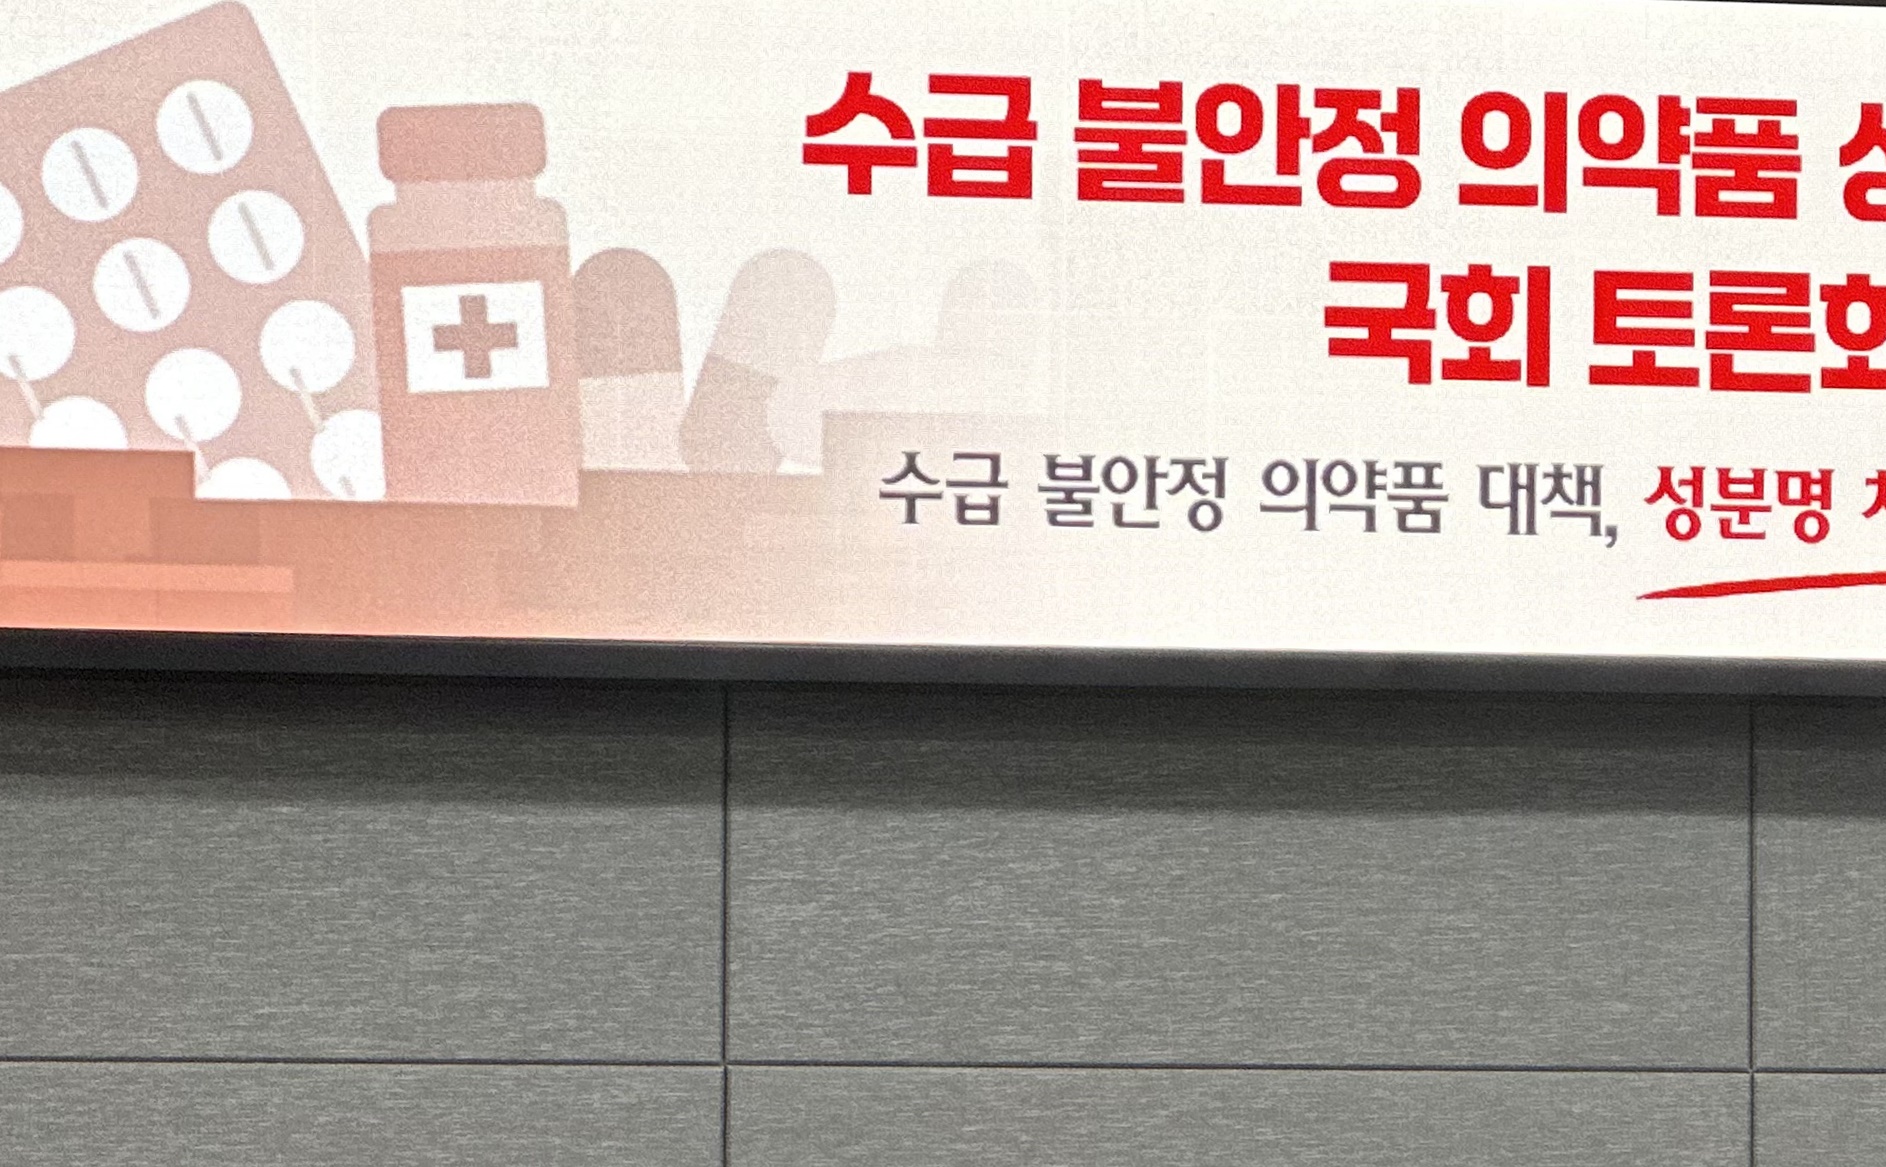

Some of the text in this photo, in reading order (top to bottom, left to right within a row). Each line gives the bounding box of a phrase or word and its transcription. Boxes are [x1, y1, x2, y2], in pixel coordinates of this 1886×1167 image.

[803, 72, 1038, 199] 수급
[1074, 79, 1422, 210] 불안정
[1459, 92, 1802, 220] 의약품
[1324, 262, 1551, 388] 국회
[879, 451, 1008, 526] 수급
[1037, 454, 1228, 532] 불안정
[1259, 459, 1449, 534] 의약품
[1479, 463, 1619, 547] 대책,
[1645, 466, 1834, 544] 성분명
